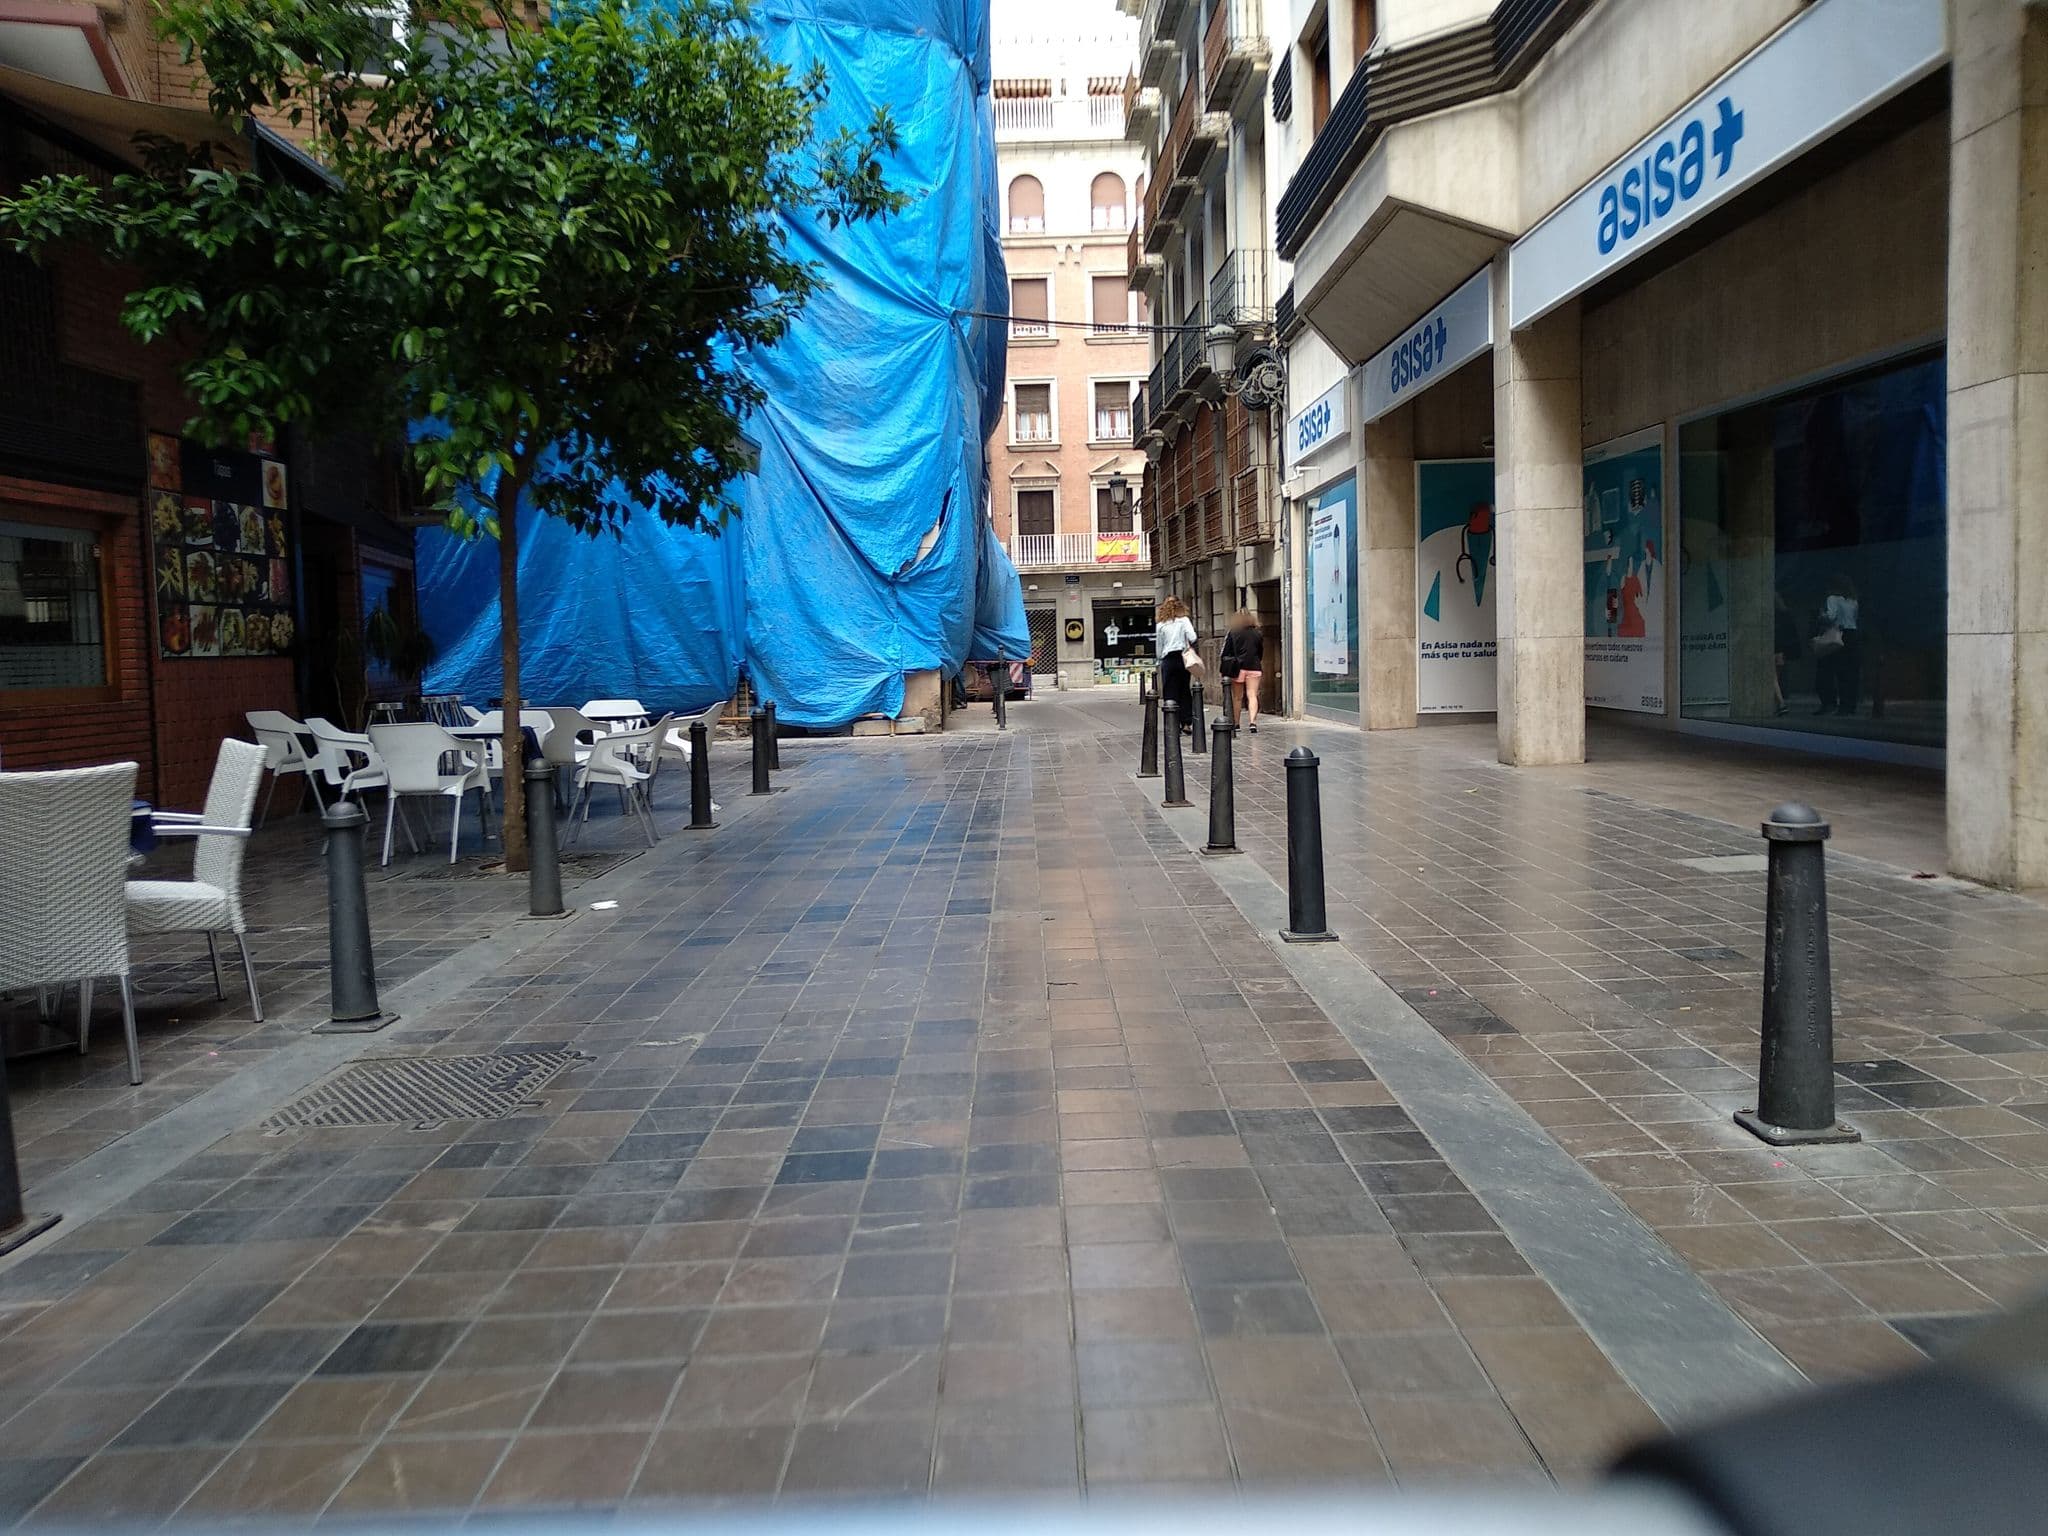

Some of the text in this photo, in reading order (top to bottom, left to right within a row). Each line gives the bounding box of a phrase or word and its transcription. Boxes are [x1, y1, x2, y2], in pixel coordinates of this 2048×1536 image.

[1421, 642, 1432, 650] En
[1434, 641, 1458, 650] Asisa
[1460, 640, 1482, 649] nada
[1421, 650, 1440, 659] más
[1442, 651, 1460, 660] que
[1473, 648, 1498, 658] salud
